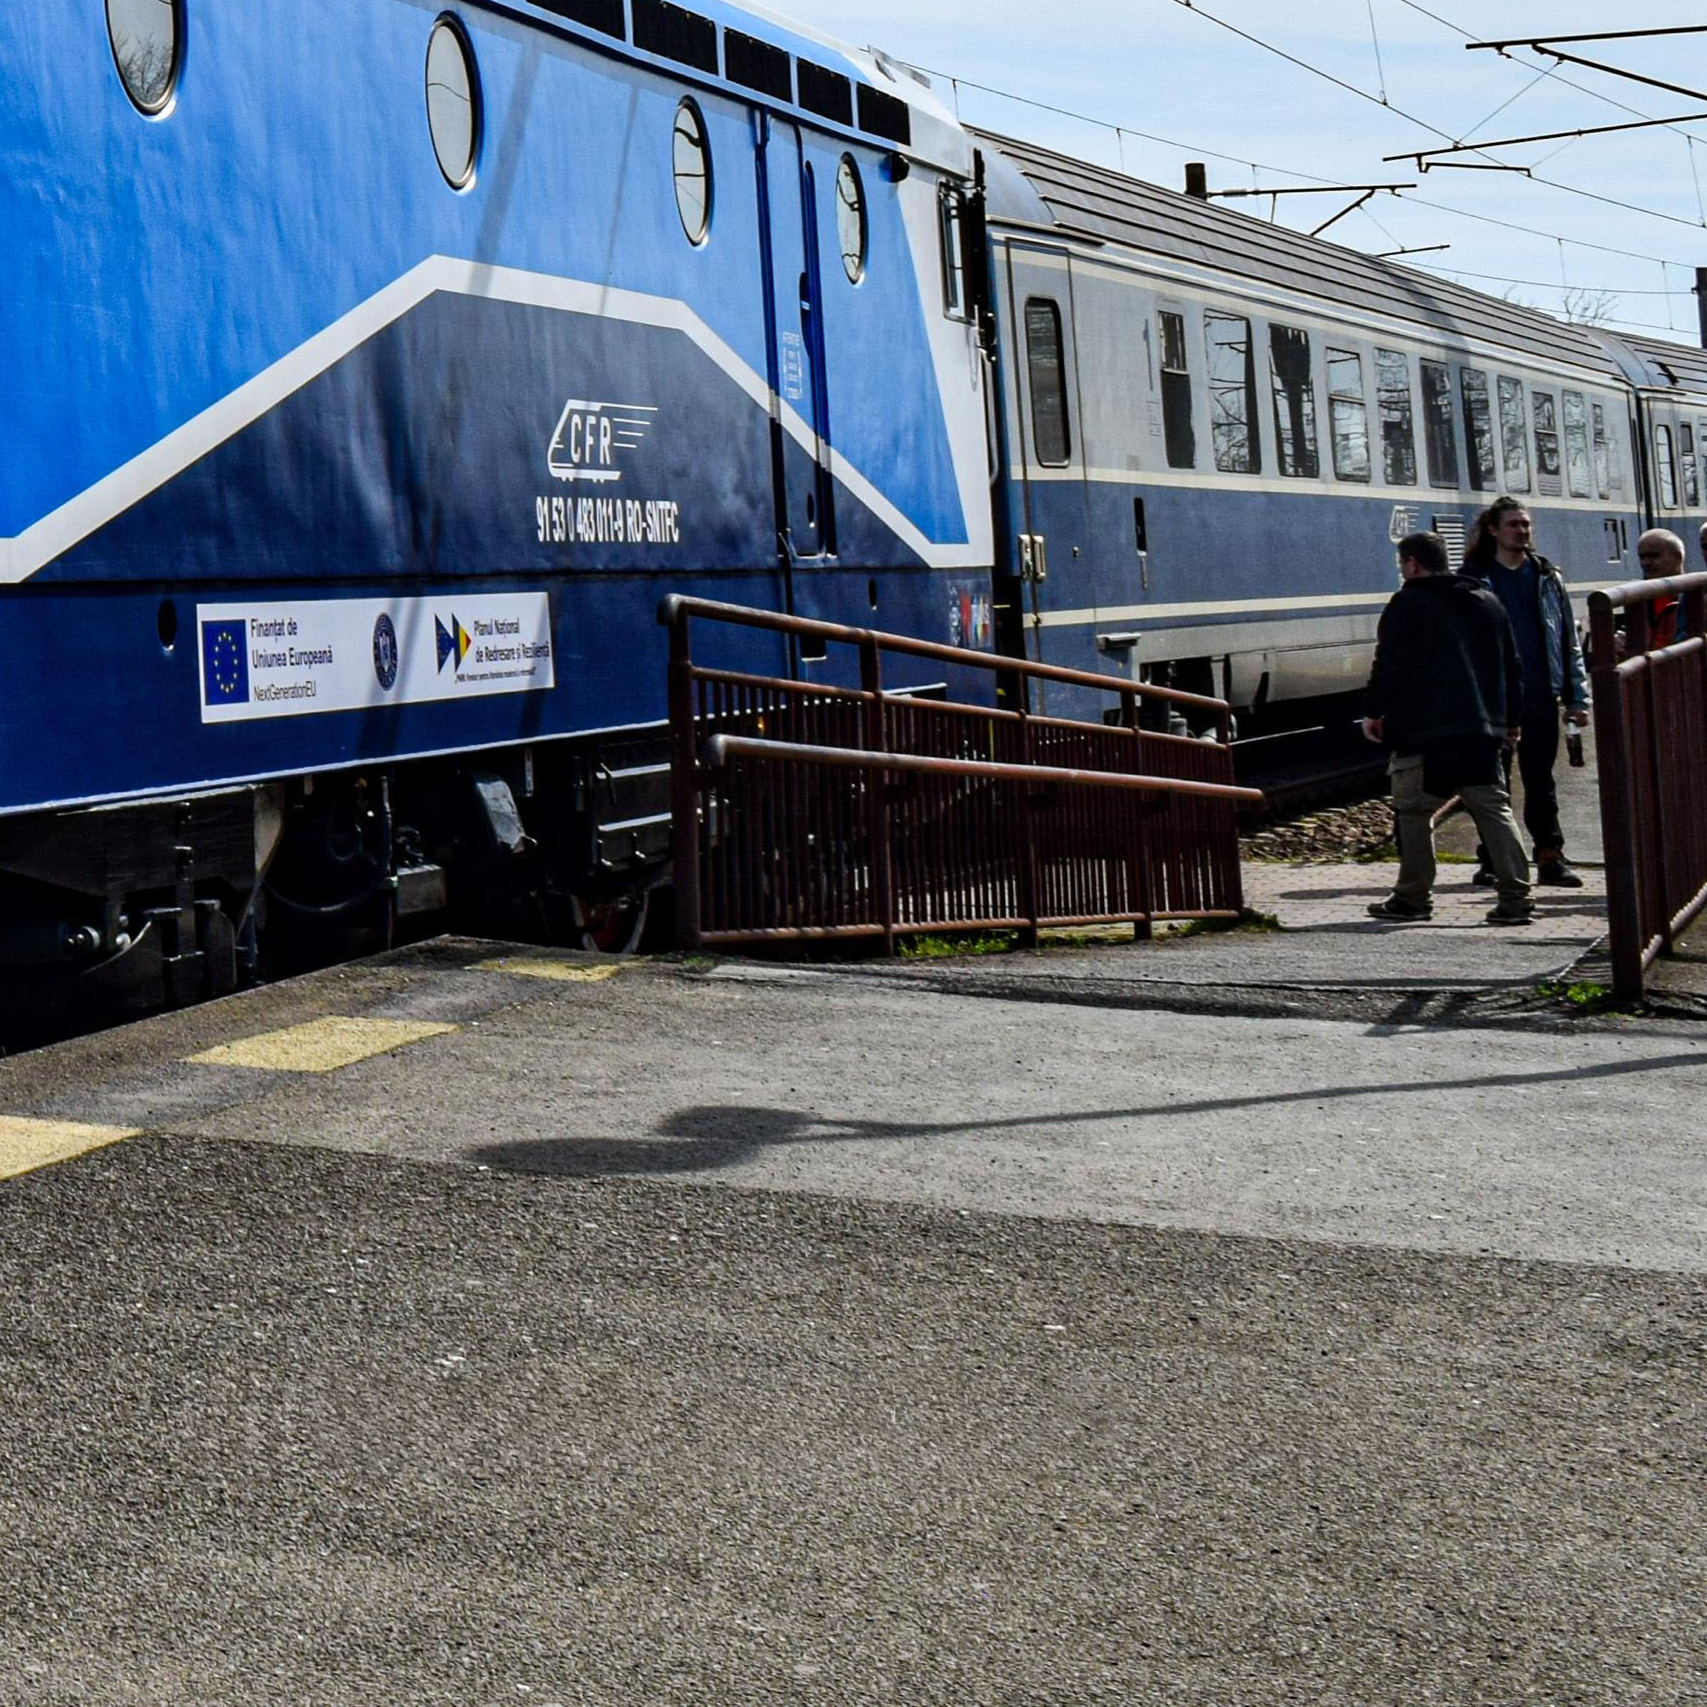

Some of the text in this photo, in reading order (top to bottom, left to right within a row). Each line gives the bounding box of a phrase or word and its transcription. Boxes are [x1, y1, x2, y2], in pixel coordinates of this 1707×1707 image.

[570, 413, 611, 466] CFR
[536, 496, 551, 542] 91
[551, 496, 566, 542] 53
[566, 497, 575, 542] 0
[576, 497, 596, 542] 483
[625, 498, 680, 543] RO-SNTFC
[286, 617, 298, 636] de
[252, 649, 287, 669] Uniunea
[475, 646, 484, 663] de
[254, 680, 317, 702] NextGenerationEU
